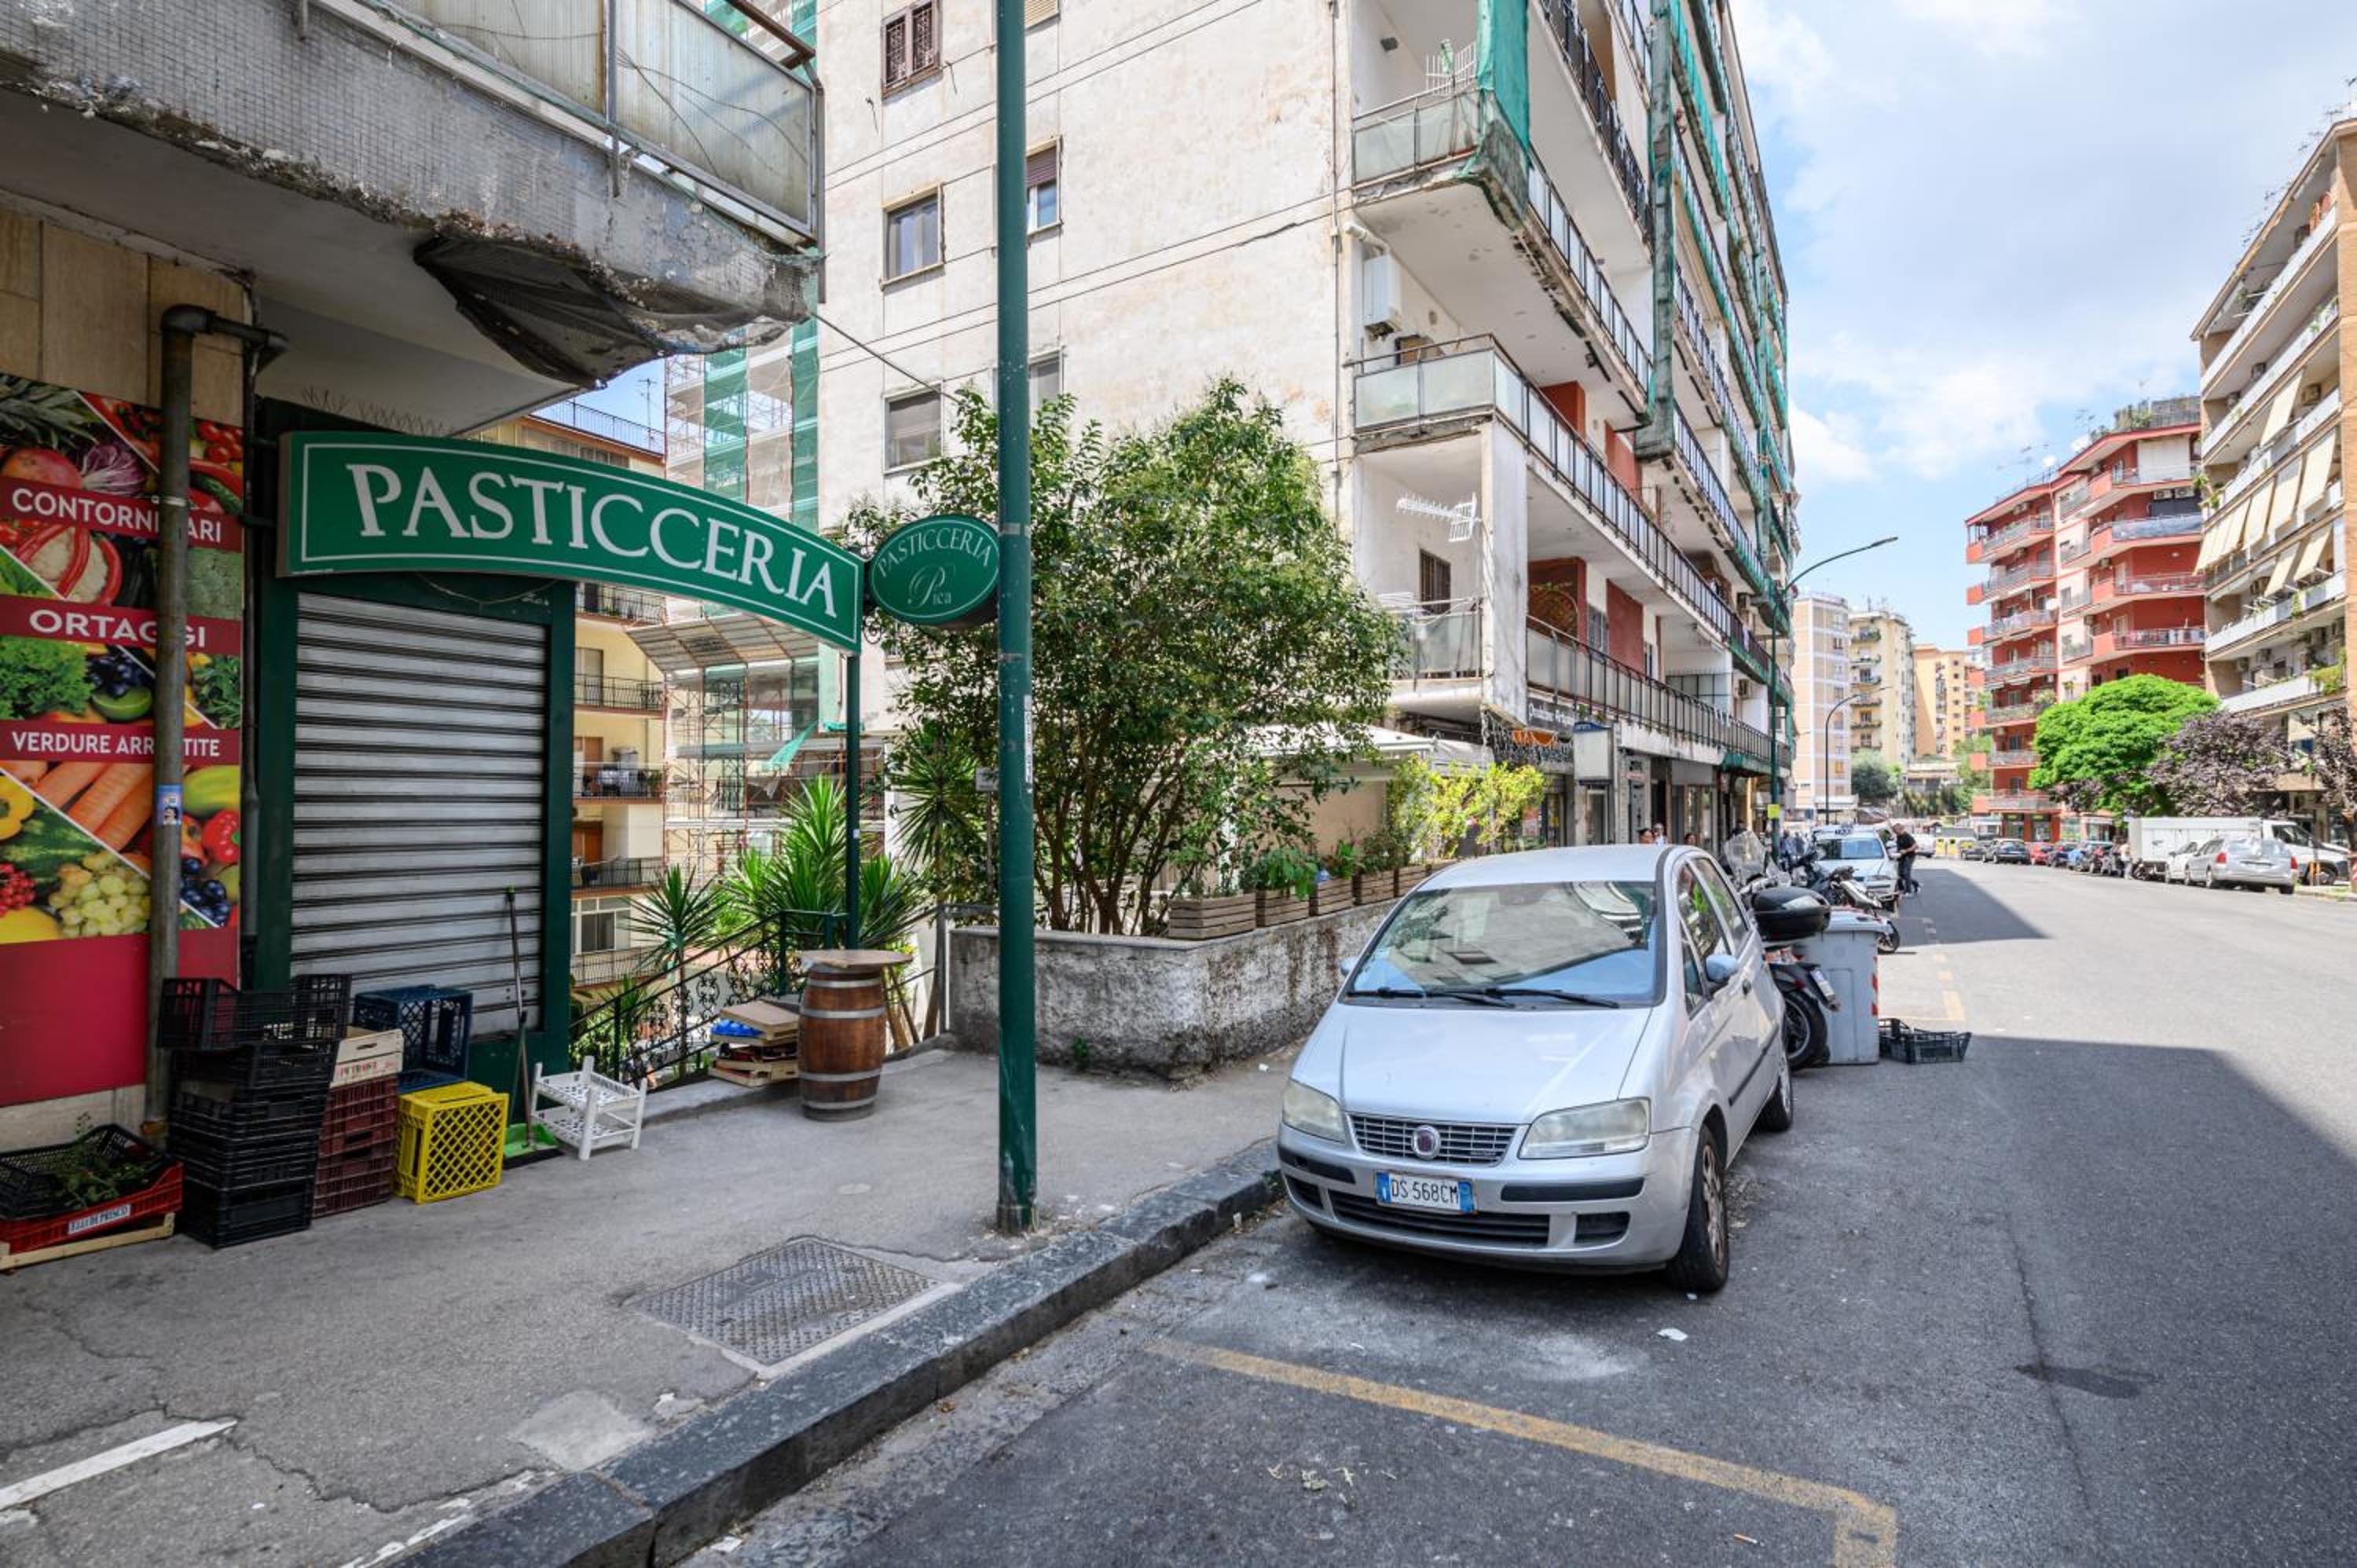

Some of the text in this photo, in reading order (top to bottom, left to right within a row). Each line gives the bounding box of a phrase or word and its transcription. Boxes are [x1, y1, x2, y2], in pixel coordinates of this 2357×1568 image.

[12, 488, 222, 544] CONTORNI ARI
[345, 463, 838, 618] PASTICCERIA
[878, 527, 992, 578] PASTICCERIA
[12, 731, 220, 757] VERDURE ARRTITE
[1391, 1179, 1408, 1198] DS
[1412, 1181, 1459, 1203] 568CM
